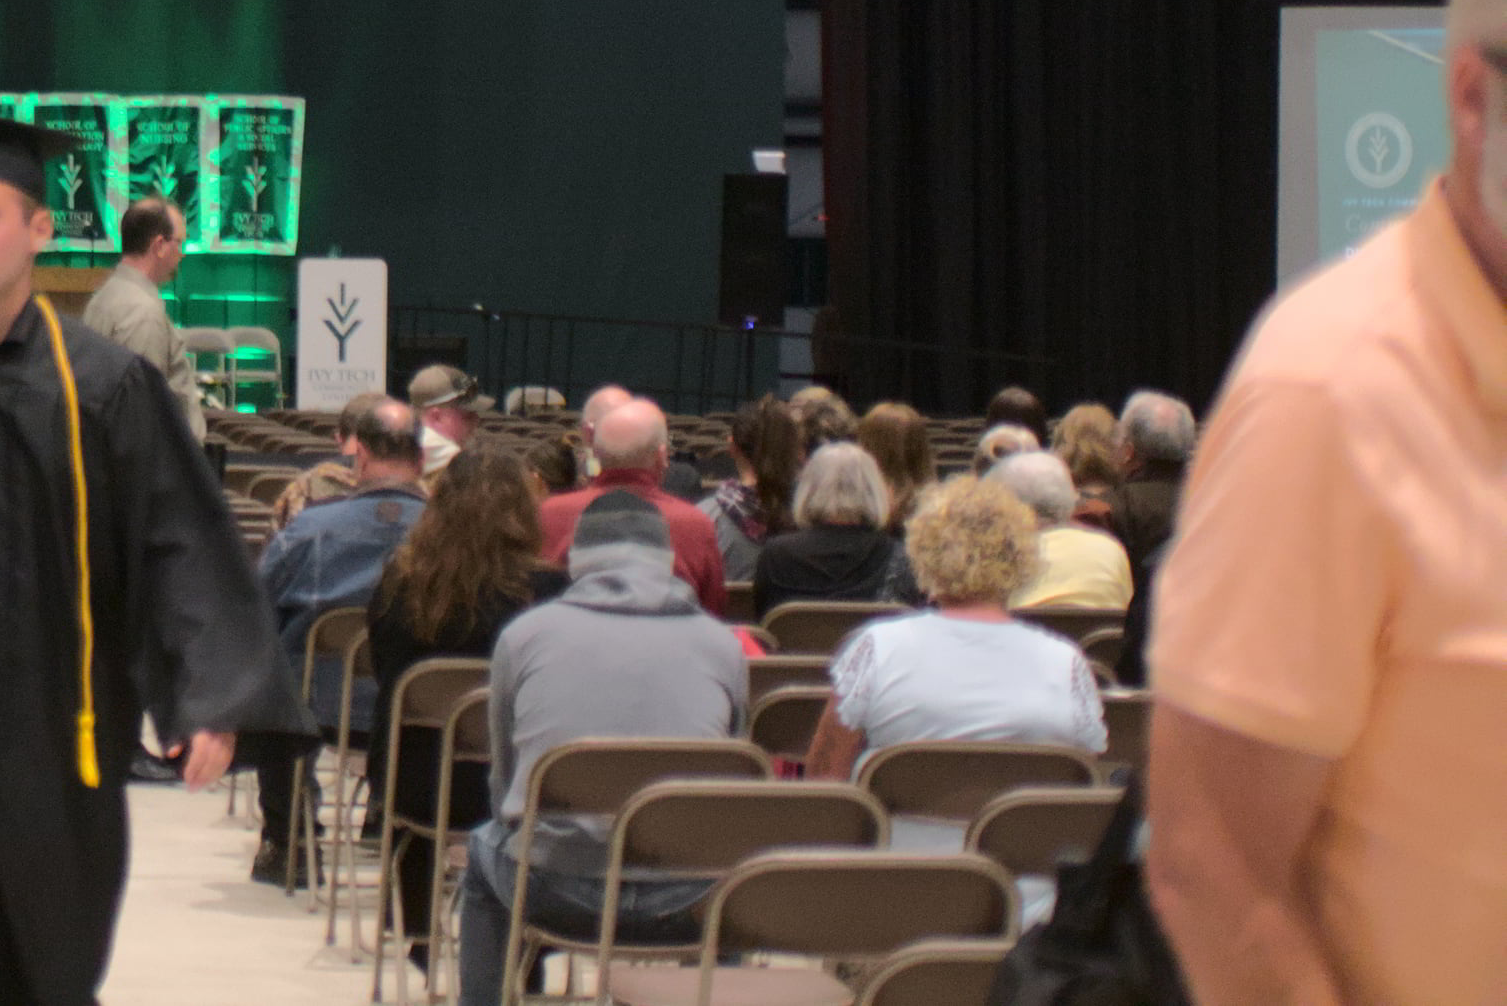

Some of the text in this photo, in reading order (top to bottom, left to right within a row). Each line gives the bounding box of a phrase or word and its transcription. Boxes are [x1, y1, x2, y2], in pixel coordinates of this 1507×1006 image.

[45, 120, 97, 130] SCHOOL OF
[137, 121, 189, 131] SCHOOL OF
[140, 133, 188, 144] NURSING
[53, 211, 93, 221] IVY TECH
[309, 368, 375, 382] IVY TECH
